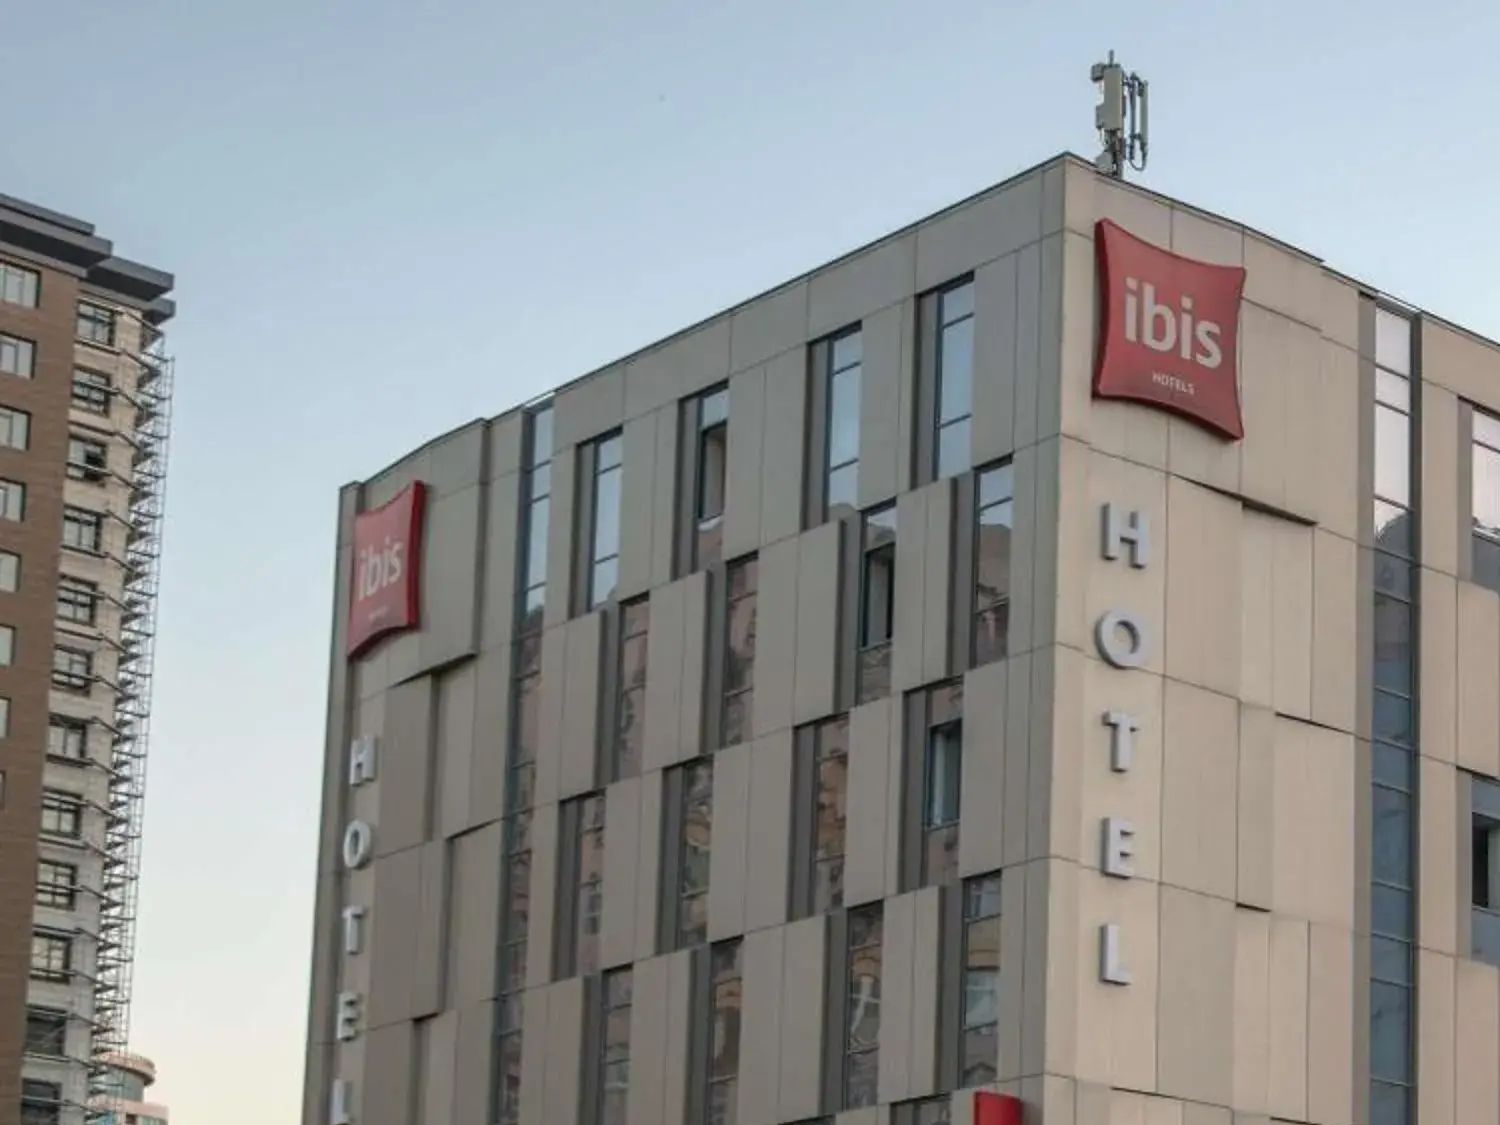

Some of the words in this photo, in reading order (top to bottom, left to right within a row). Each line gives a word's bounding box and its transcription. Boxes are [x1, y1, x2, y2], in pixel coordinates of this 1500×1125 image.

[1125, 276, 1222, 369] ibis
[1152, 371, 1196, 395] HOTELS
[357, 535, 403, 600] ibis
[1094, 502, 1149, 986] HOTEL
